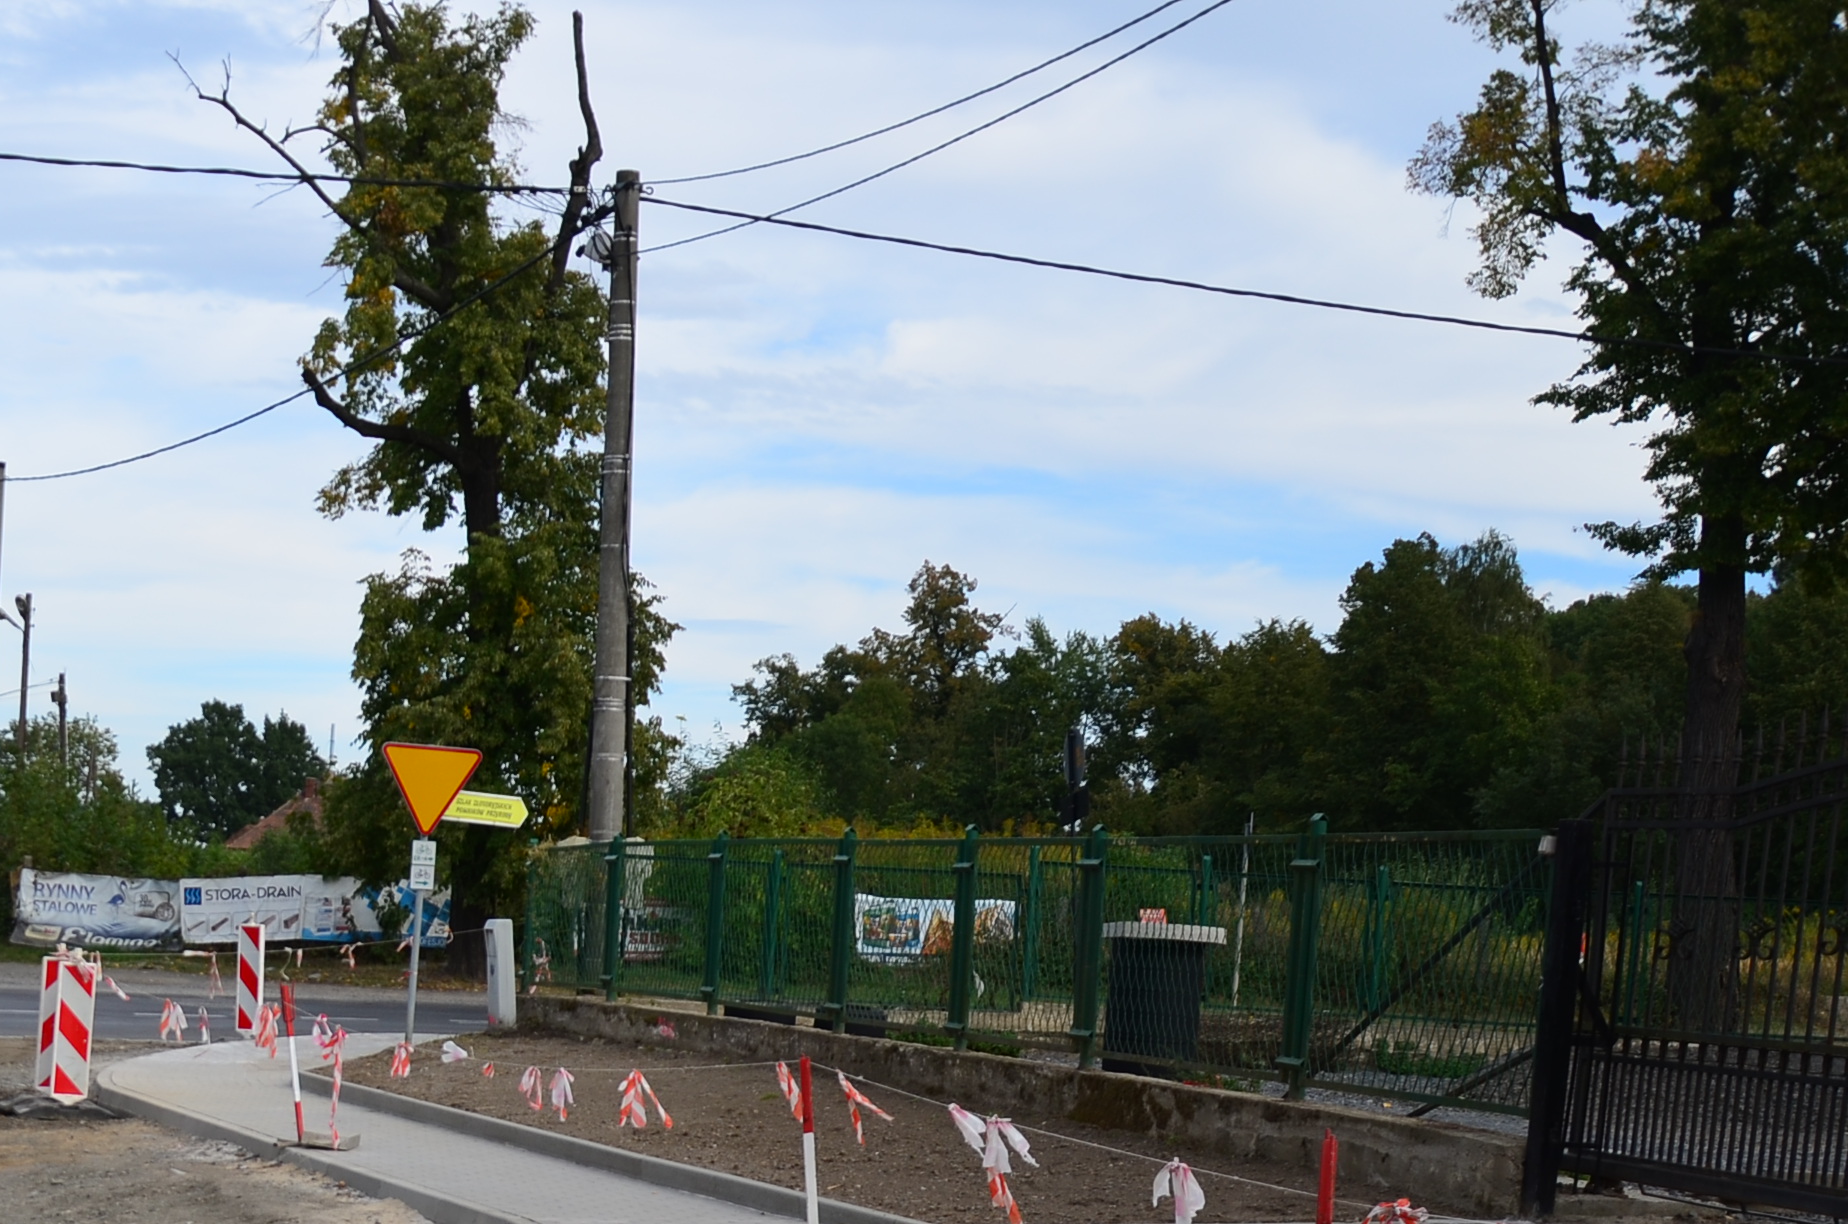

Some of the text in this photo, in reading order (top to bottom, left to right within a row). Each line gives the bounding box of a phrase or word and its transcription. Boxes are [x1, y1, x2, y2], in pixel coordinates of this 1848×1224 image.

[33, 882, 95, 900] RYNNY
[205, 886, 302, 901] STORA-DRAIN
[33, 900, 97, 915] STALOWE
